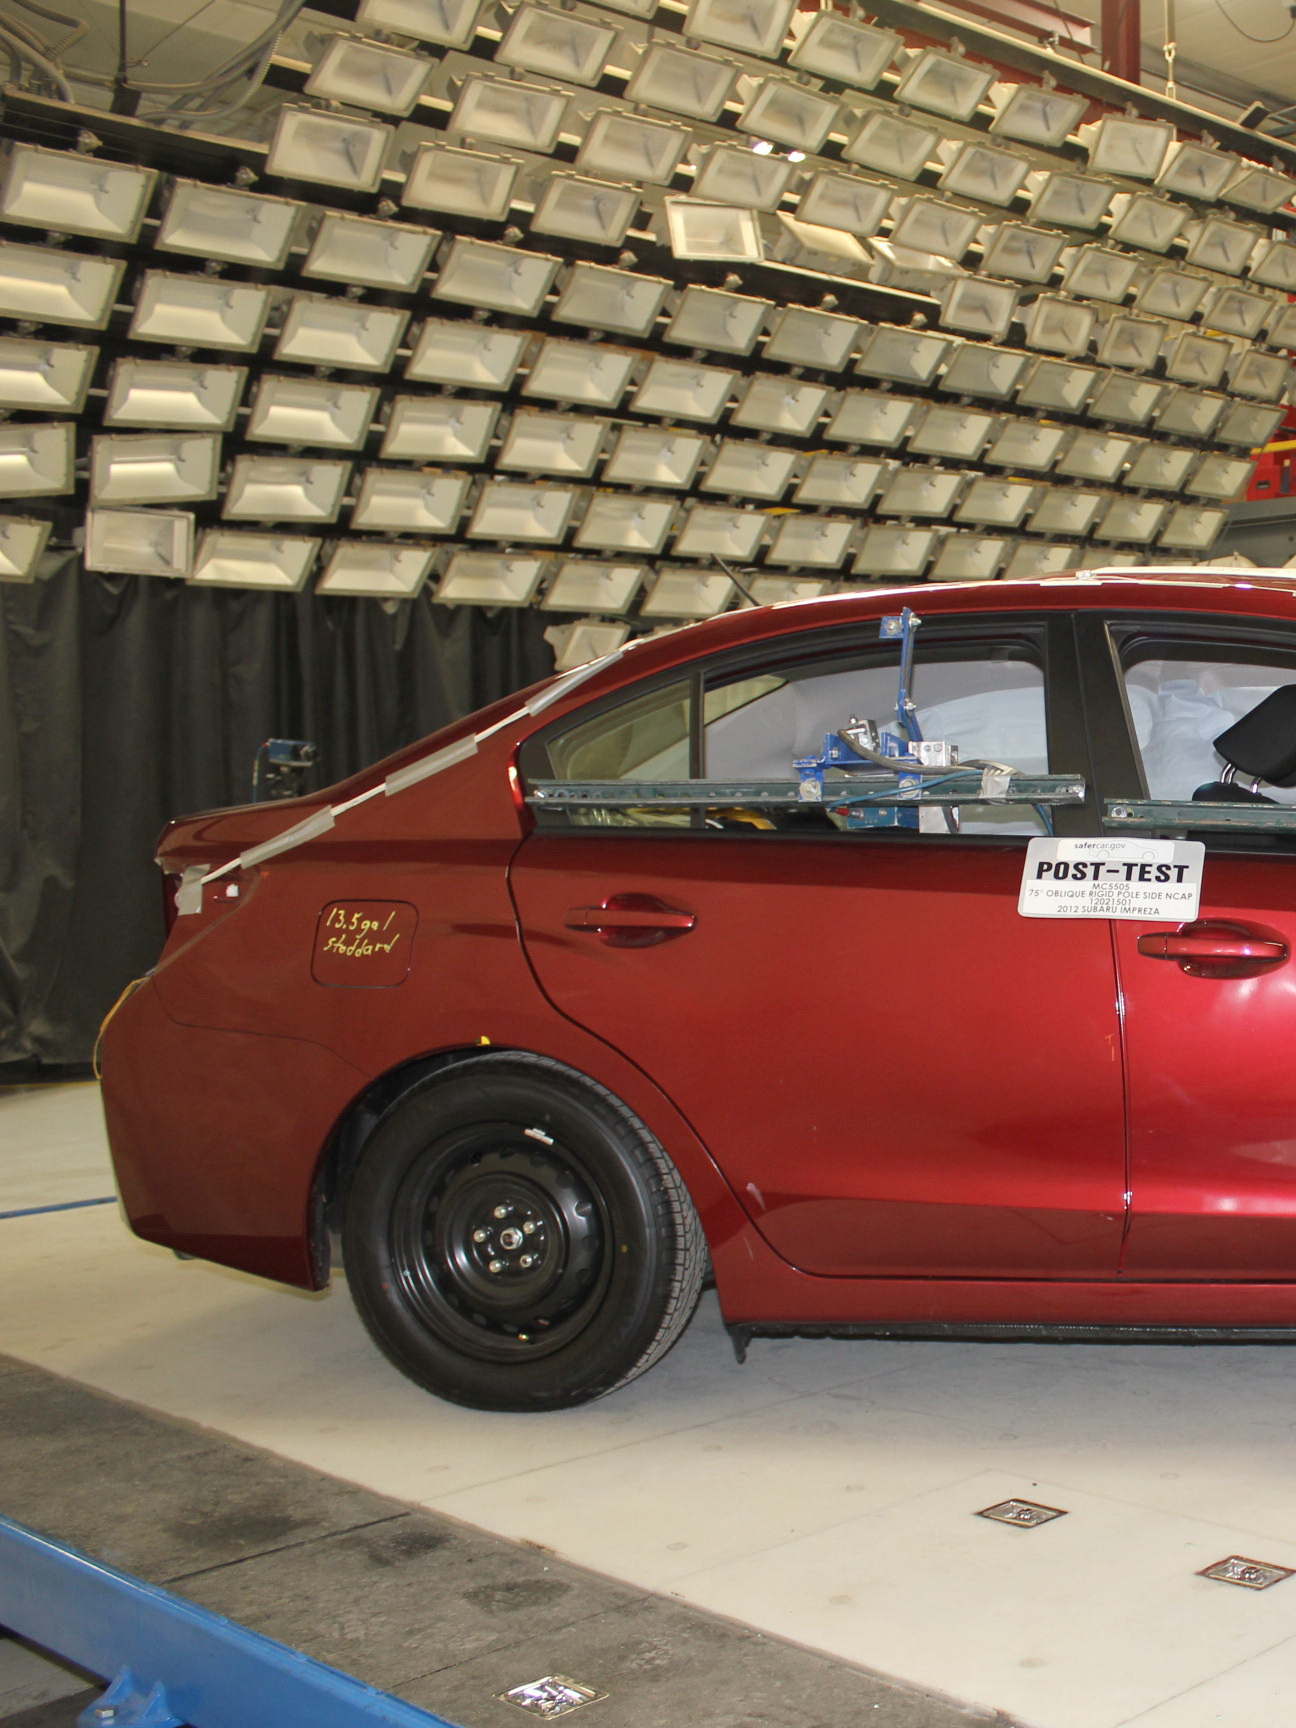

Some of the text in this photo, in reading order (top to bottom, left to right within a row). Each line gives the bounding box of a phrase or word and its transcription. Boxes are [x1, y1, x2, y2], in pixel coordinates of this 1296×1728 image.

[1073, 841, 1127, 851] safercar.gov
[1035, 861, 1190, 883] POST-TEST
[1092, 882, 1130, 891] MC5505
[1046, 889, 1087, 898] OBLIQUE
[1088, 890, 1115, 899] RIGID
[1117, 890, 1140, 899] POLE
[1142, 891, 1163, 900] SIDE
[1165, 892, 1193, 901] NCAP
[1090, 898, 1132, 906] 12021501
[1057, 905, 1160, 915] 2012 SUBARU IMPREZA
